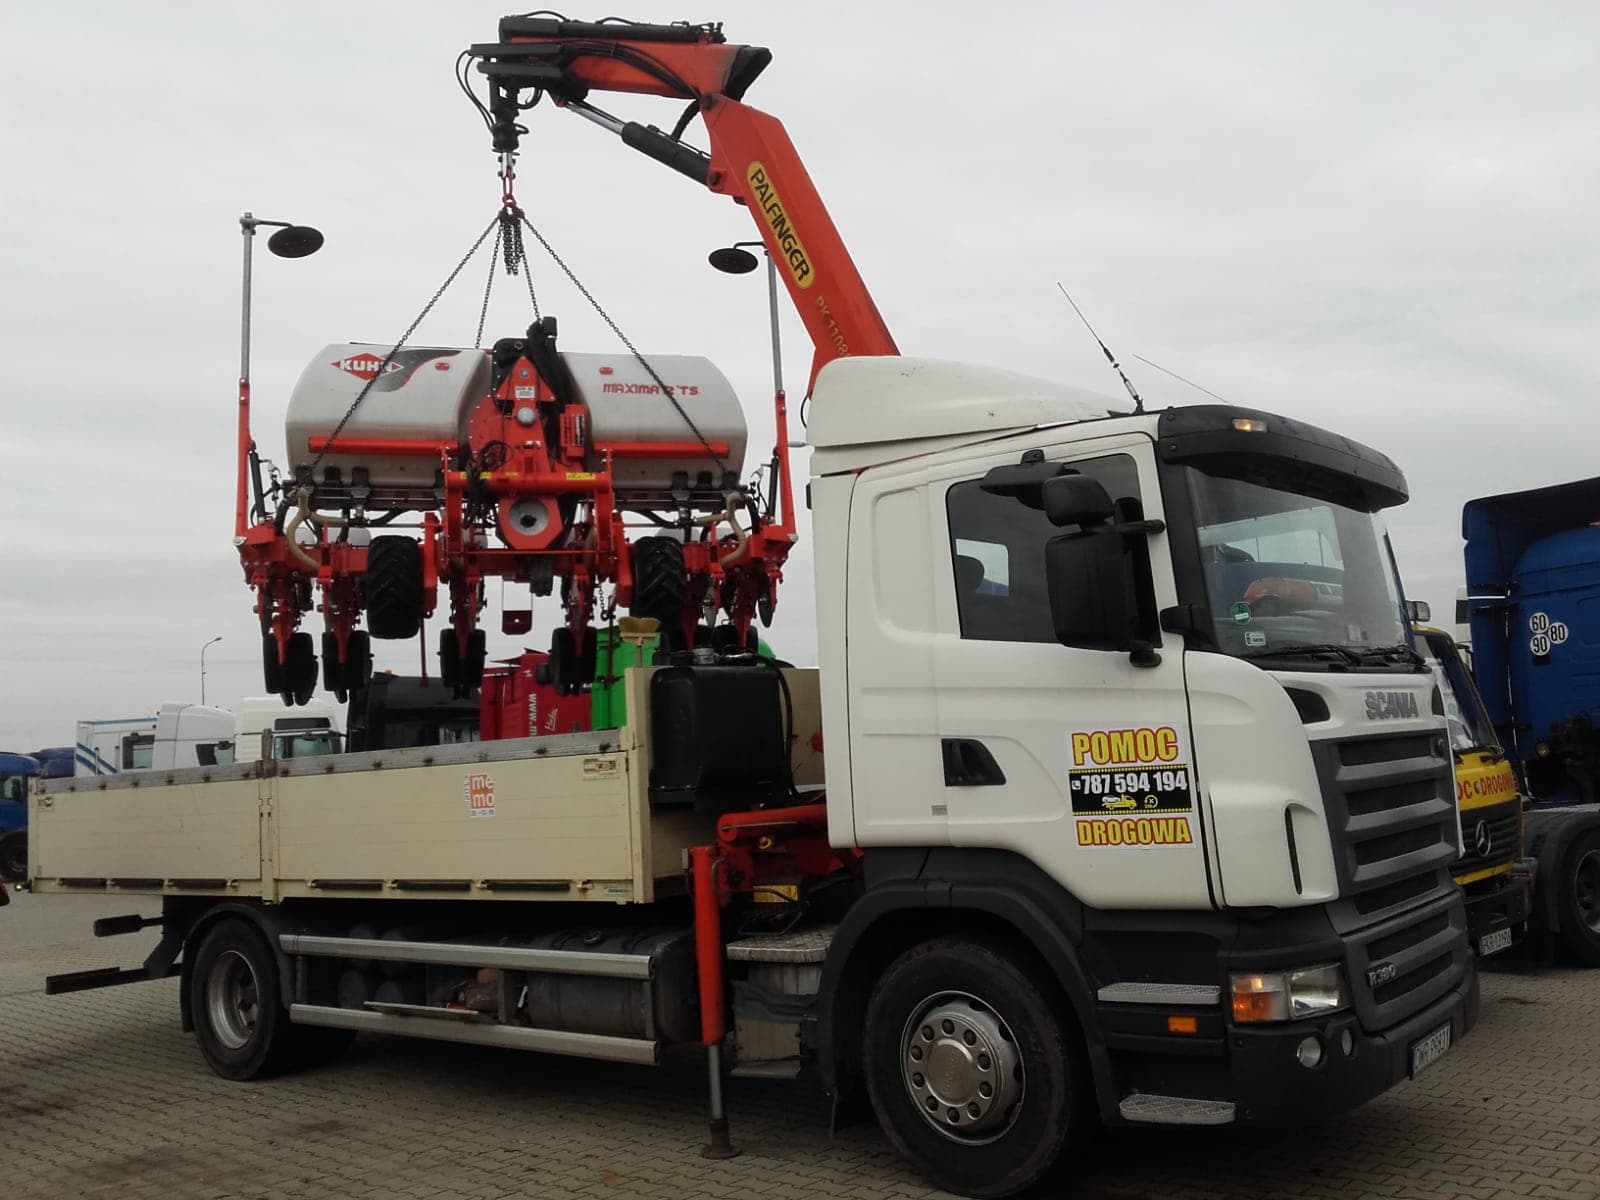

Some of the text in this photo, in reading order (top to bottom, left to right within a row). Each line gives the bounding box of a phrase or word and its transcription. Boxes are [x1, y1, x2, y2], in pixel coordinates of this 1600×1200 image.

[750, 168, 810, 281] PALFINGER
[603, 383, 660, 394] MAXIMA
[679, 385, 699, 396] TS
[1531, 614, 1547, 631] 60
[1550, 624, 1566, 642] 80
[1532, 636, 1548, 653] 90
[1365, 691, 1419, 720] SCANIA
[1072, 727, 1178, 766] POMOC
[1081, 770, 1188, 794] 787 594 194
[1076, 817, 1193, 845] DROGOWA
